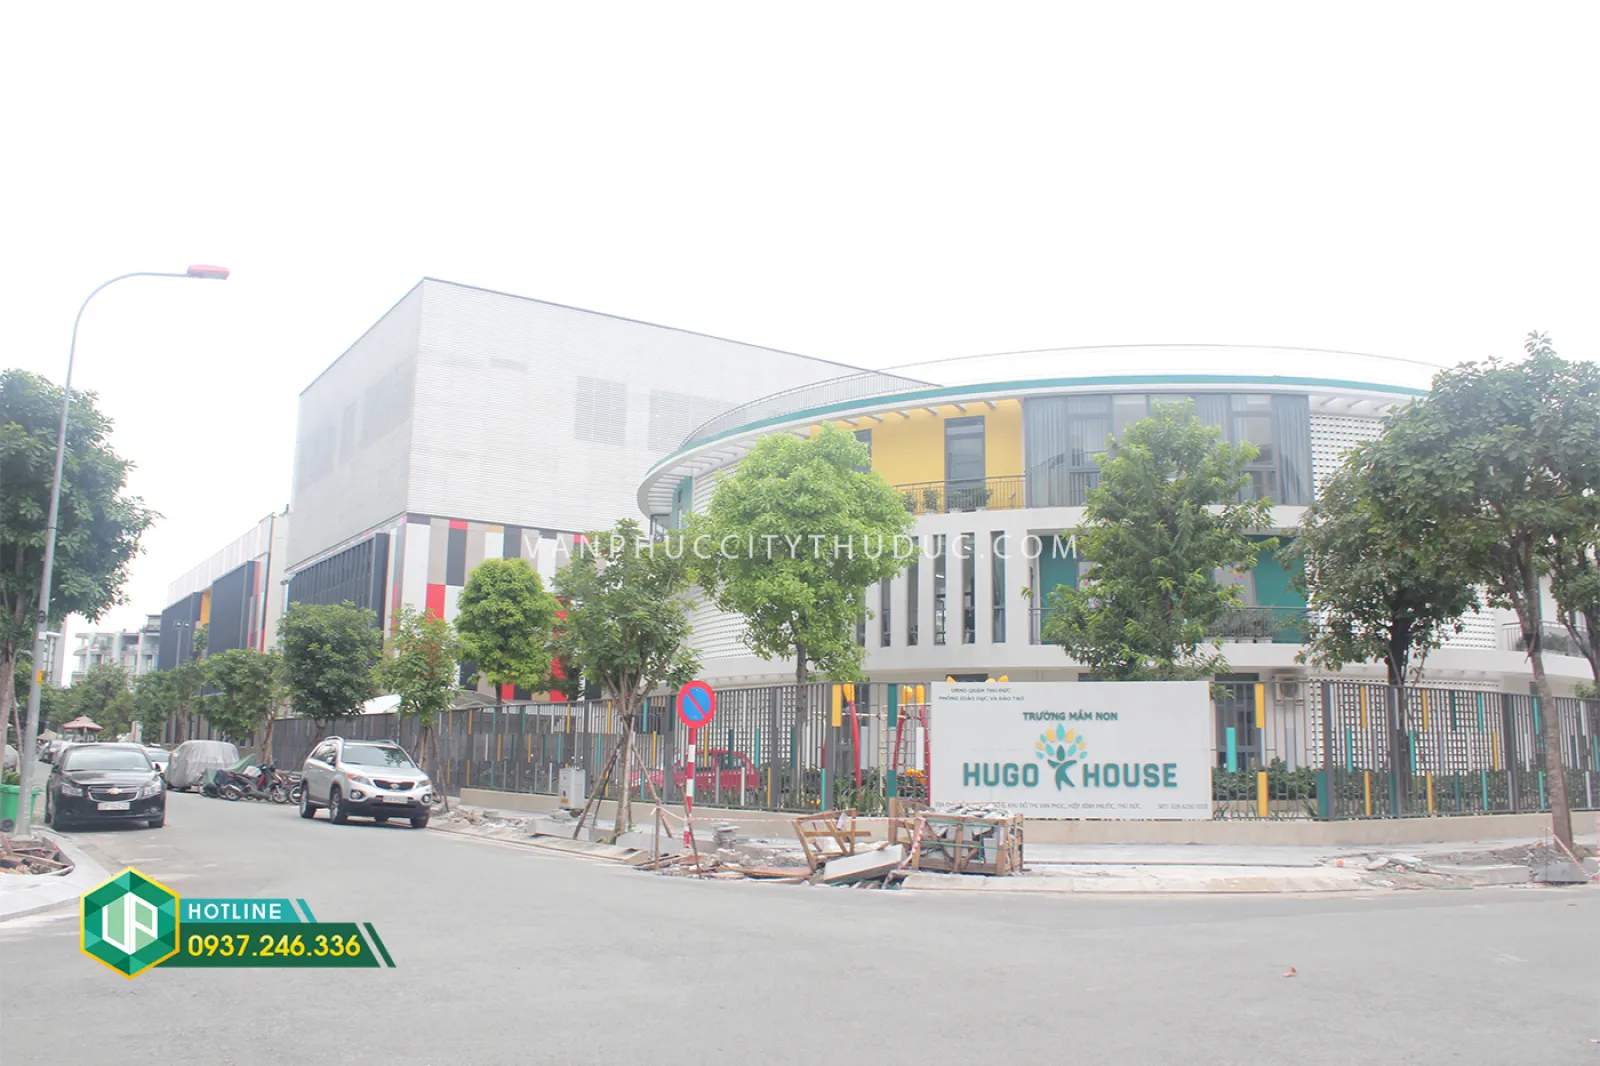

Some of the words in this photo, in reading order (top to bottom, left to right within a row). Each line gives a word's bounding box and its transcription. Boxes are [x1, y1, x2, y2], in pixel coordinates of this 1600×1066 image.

[1023, 709, 1066, 721] TRƯỜNG
[1095, 711, 1118, 721] NON
[963, 763, 1040, 788] HUGO
[1083, 763, 1178, 788] HOUSE
